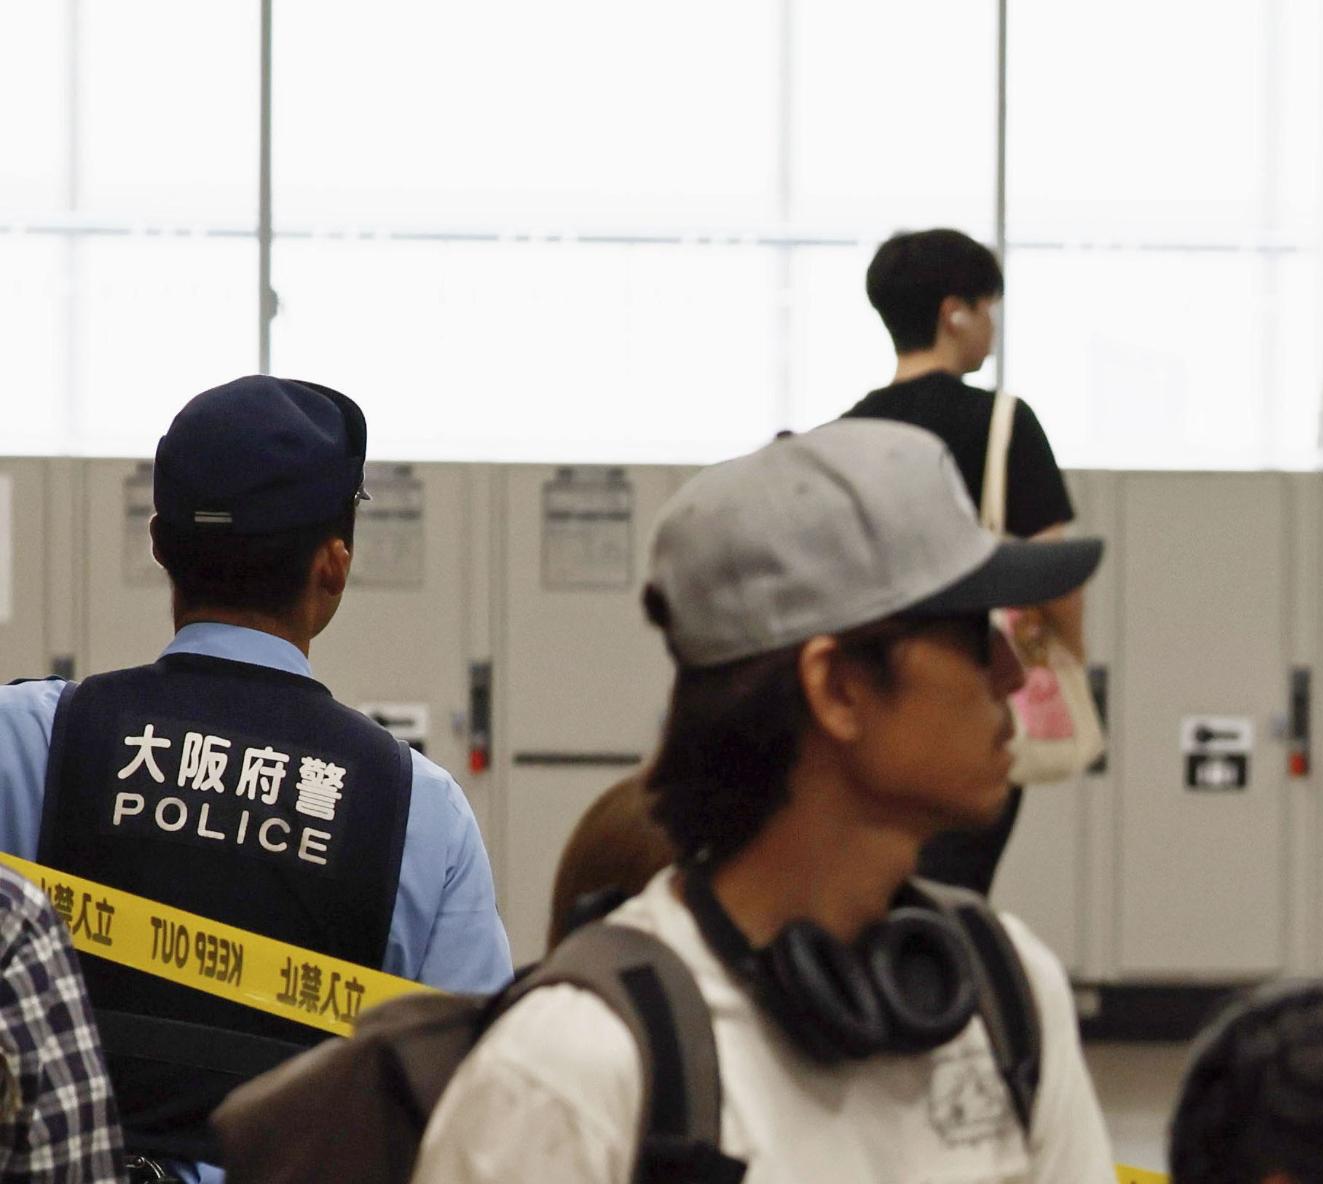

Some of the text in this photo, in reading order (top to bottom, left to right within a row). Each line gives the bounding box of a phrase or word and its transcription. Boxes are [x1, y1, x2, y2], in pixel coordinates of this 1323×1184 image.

[117, 723, 347, 821] 大阪府警
[112, 791, 334, 865] POLICE
